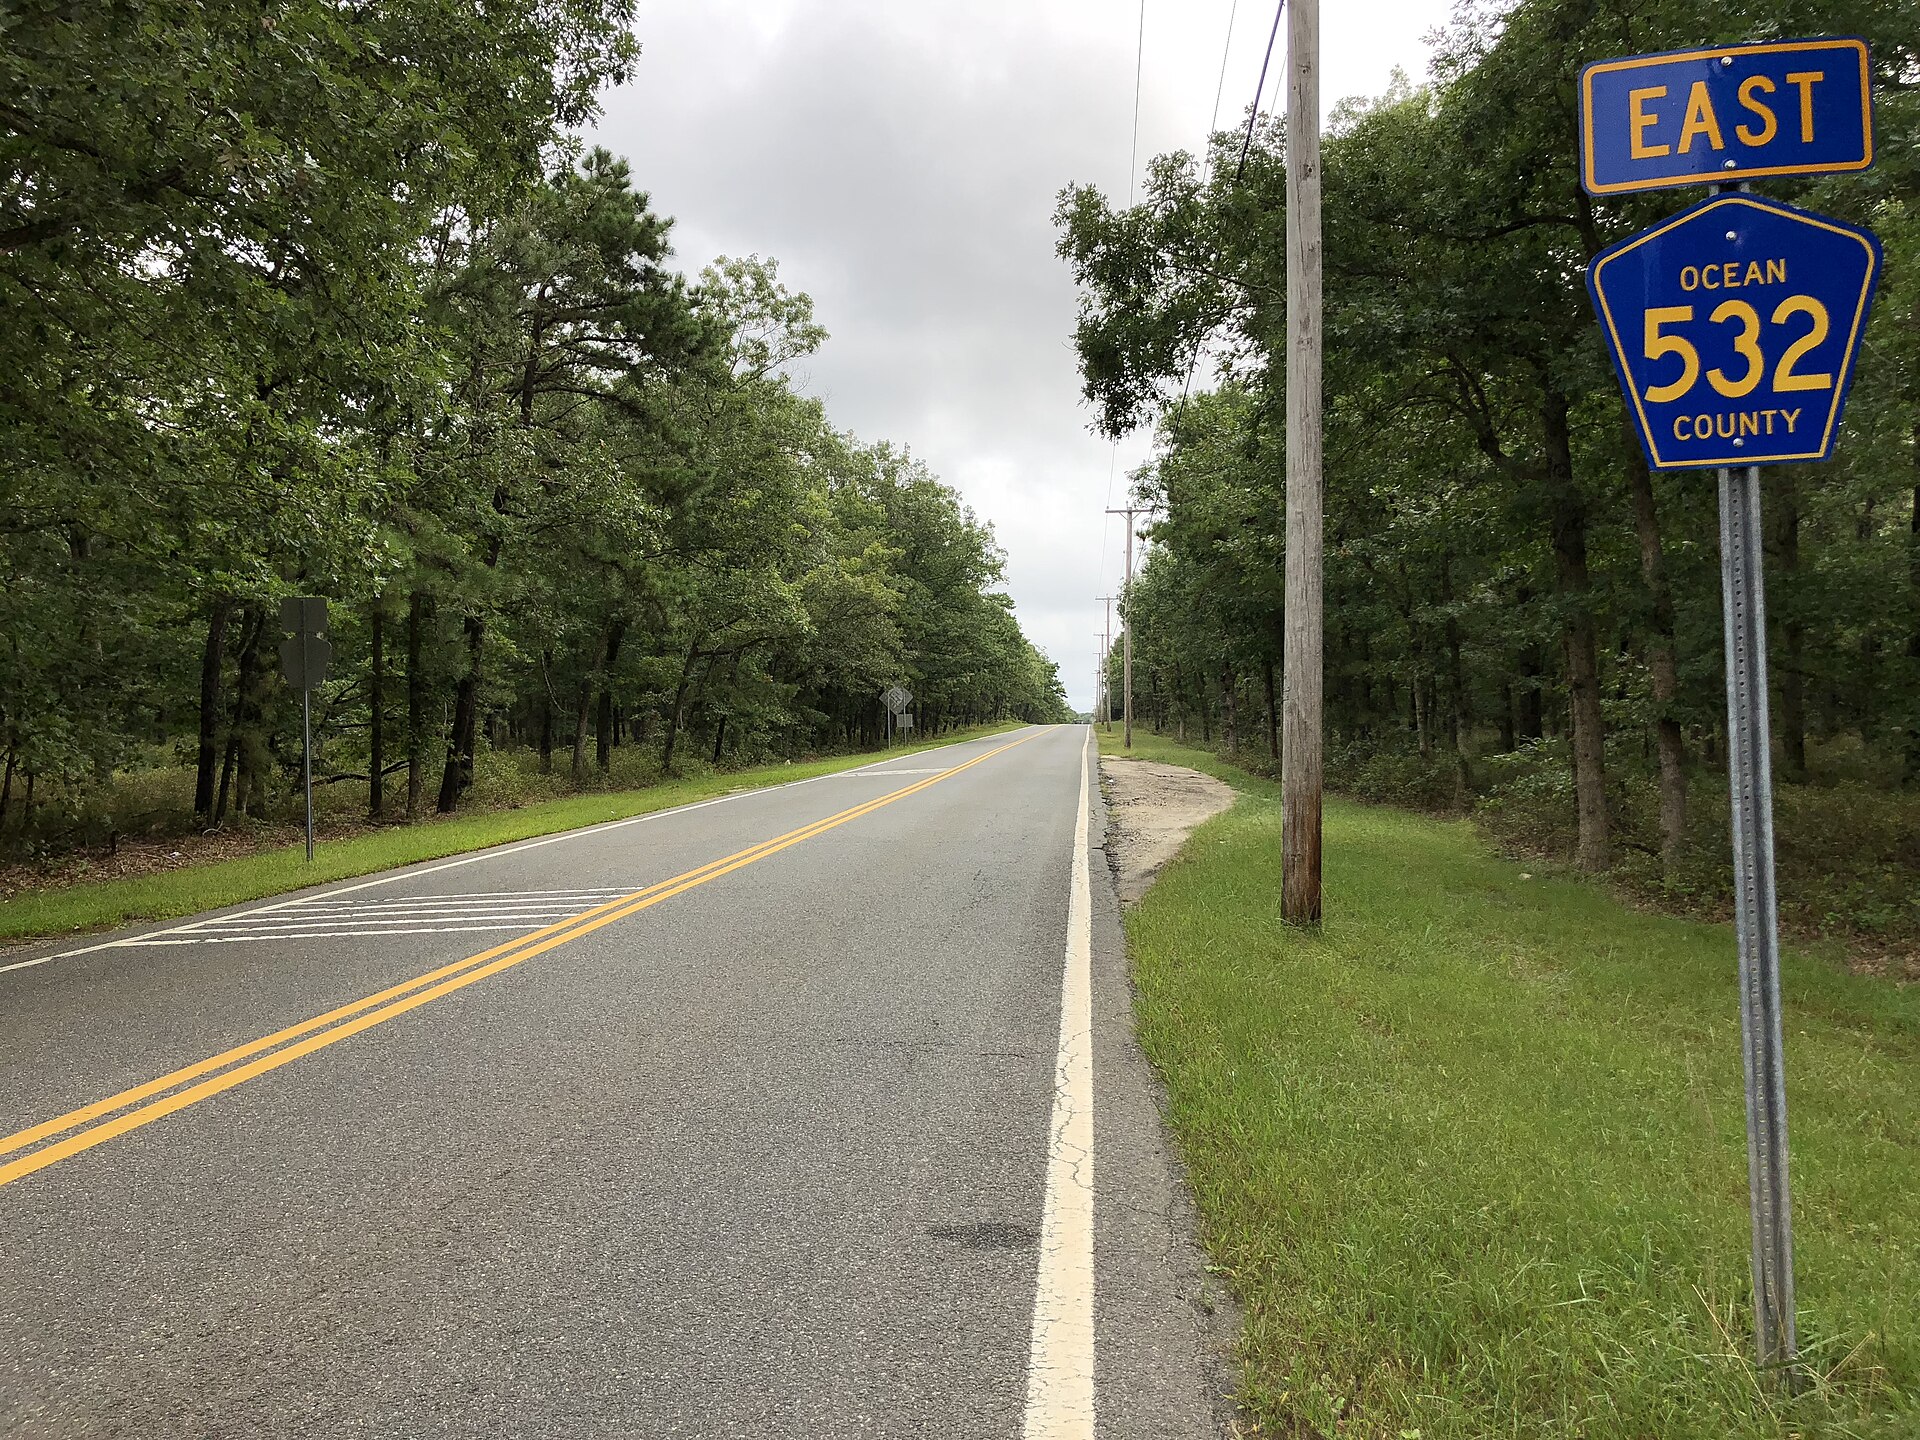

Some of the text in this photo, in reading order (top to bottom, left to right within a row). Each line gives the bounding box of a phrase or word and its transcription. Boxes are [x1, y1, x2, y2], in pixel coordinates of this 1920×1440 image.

[1629, 71, 1824, 160] EAST
[1680, 259, 1786, 292] OCEAN
[1644, 294, 1832, 403] 532
[1673, 408, 1801, 441] COUNTY
